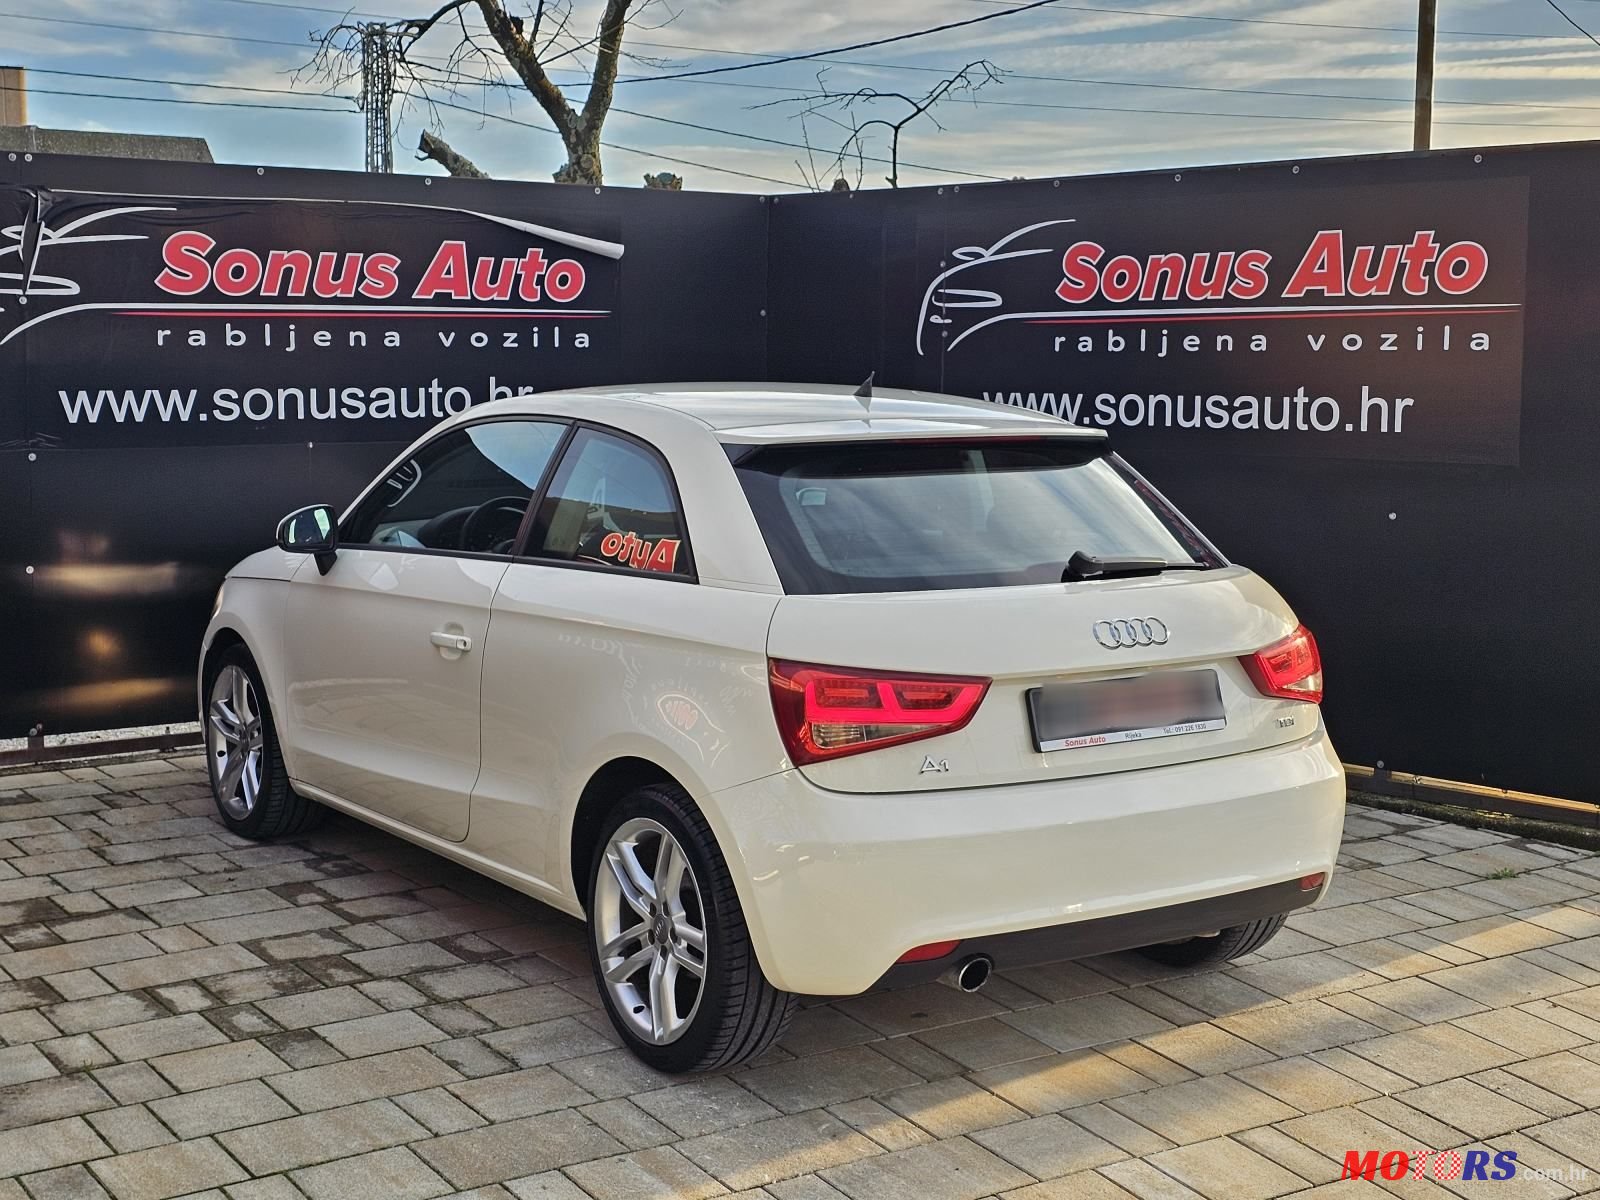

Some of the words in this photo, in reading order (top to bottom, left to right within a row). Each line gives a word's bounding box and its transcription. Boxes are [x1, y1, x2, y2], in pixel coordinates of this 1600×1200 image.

[154, 231, 401, 298] Sonus
[412, 240, 586, 302] Auto
[1056, 241, 1272, 303] Sonus
[1281, 230, 1488, 297] Auto
[156, 323, 400, 352] rabljena
[438, 326, 590, 348] vozila
[1054, 329, 1268, 358] rabljena
[1307, 325, 1490, 352] vozila
[58, 376, 534, 424] www.sonusautohr
[1064, 739, 1087, 747] Sonus
[1089, 736, 1106, 744] Auto
[1124, 732, 1142, 740] Rijeka
[919, 754, 949, 774] A1
